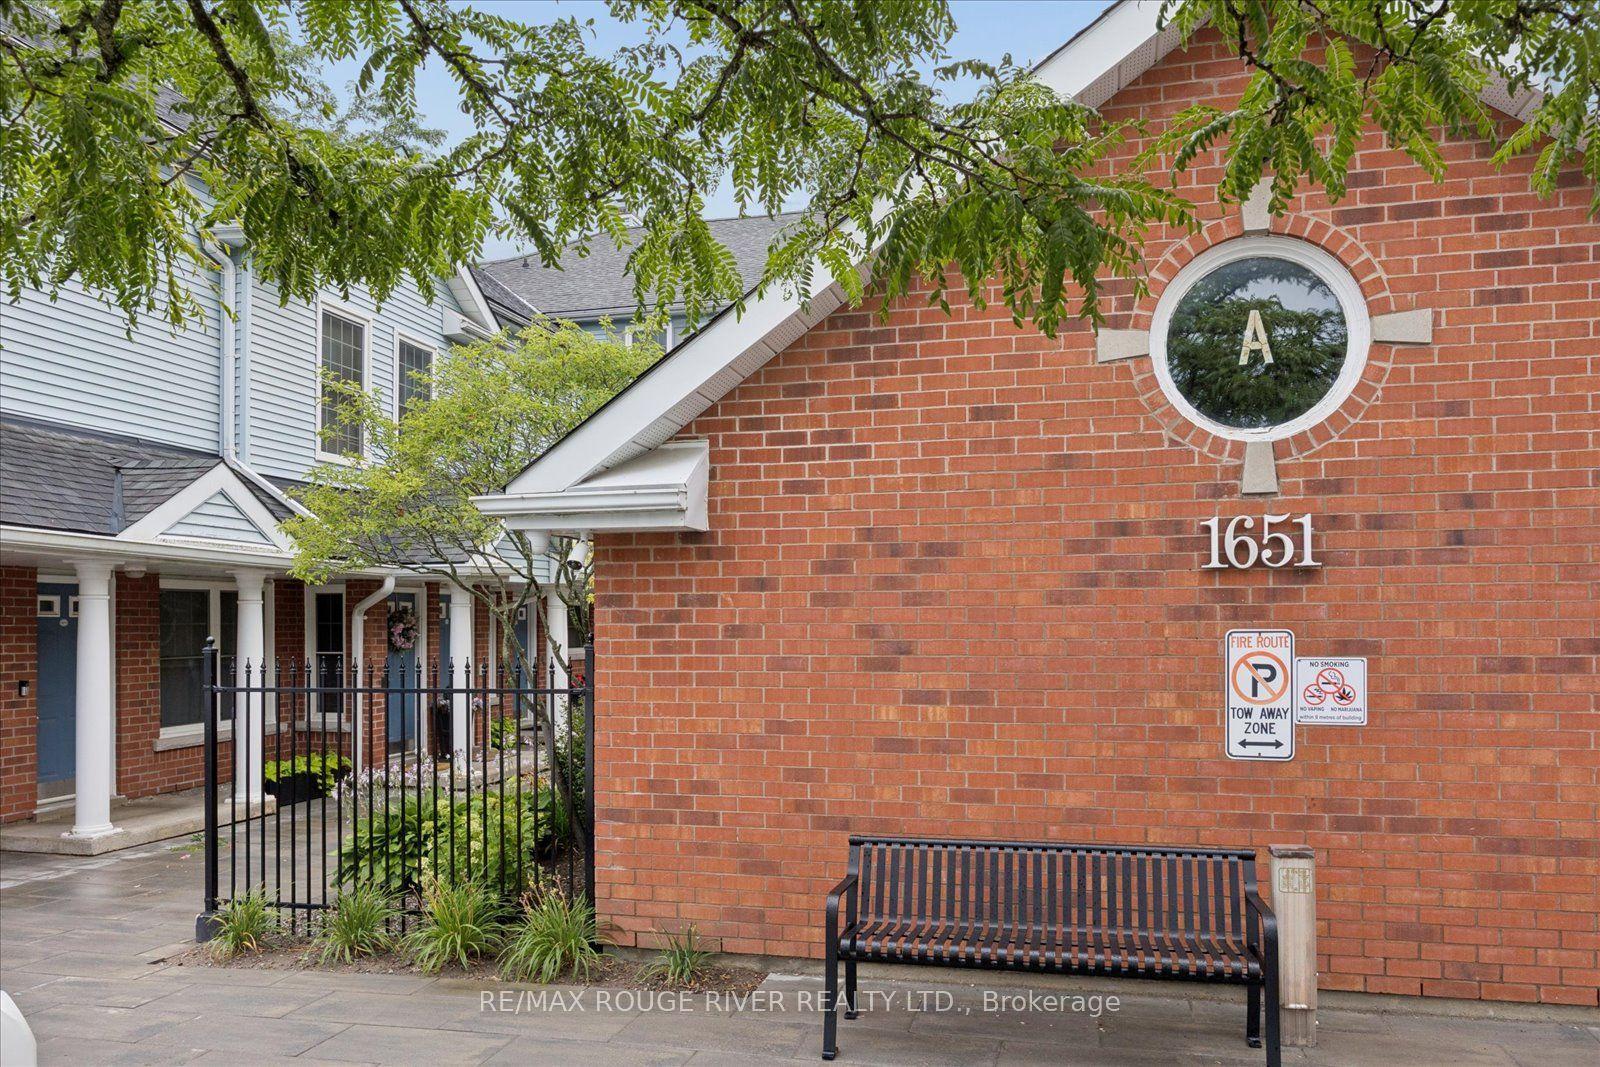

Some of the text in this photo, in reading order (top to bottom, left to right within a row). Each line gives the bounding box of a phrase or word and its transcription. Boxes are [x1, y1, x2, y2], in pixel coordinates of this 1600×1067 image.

[1239, 310, 1273, 365] A
[1200, 513, 1322, 569] 1651
[1231, 635, 1290, 648] FIRE ROUTE
[1251, 663, 1277, 698] P
[1231, 707, 1290, 720] TOW AWAY
[1244, 722, 1276, 735] ZONE
